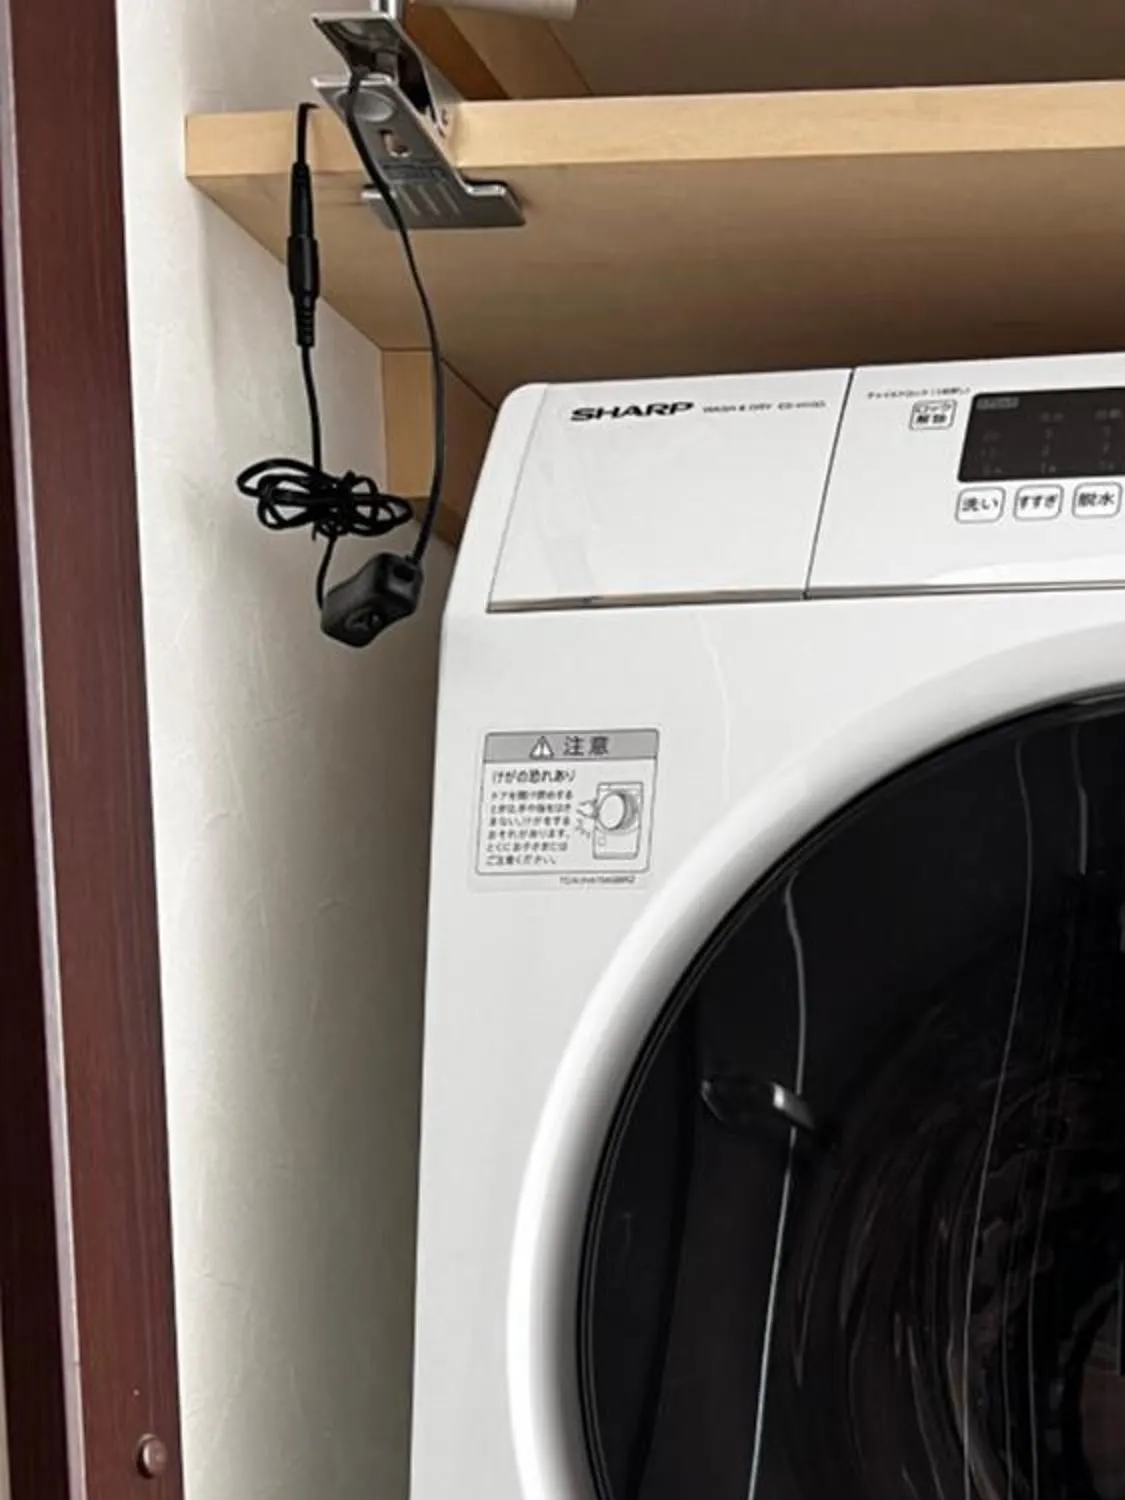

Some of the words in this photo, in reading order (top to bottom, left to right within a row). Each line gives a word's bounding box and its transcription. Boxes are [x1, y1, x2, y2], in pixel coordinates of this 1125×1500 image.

[570, 401, 694, 422] SHARP
[962, 496, 999, 511] 洗い
[1020, 494, 1057, 509] すすぎ
[1077, 491, 1115, 508] 脱水
[563, 735, 609, 757] 注意
